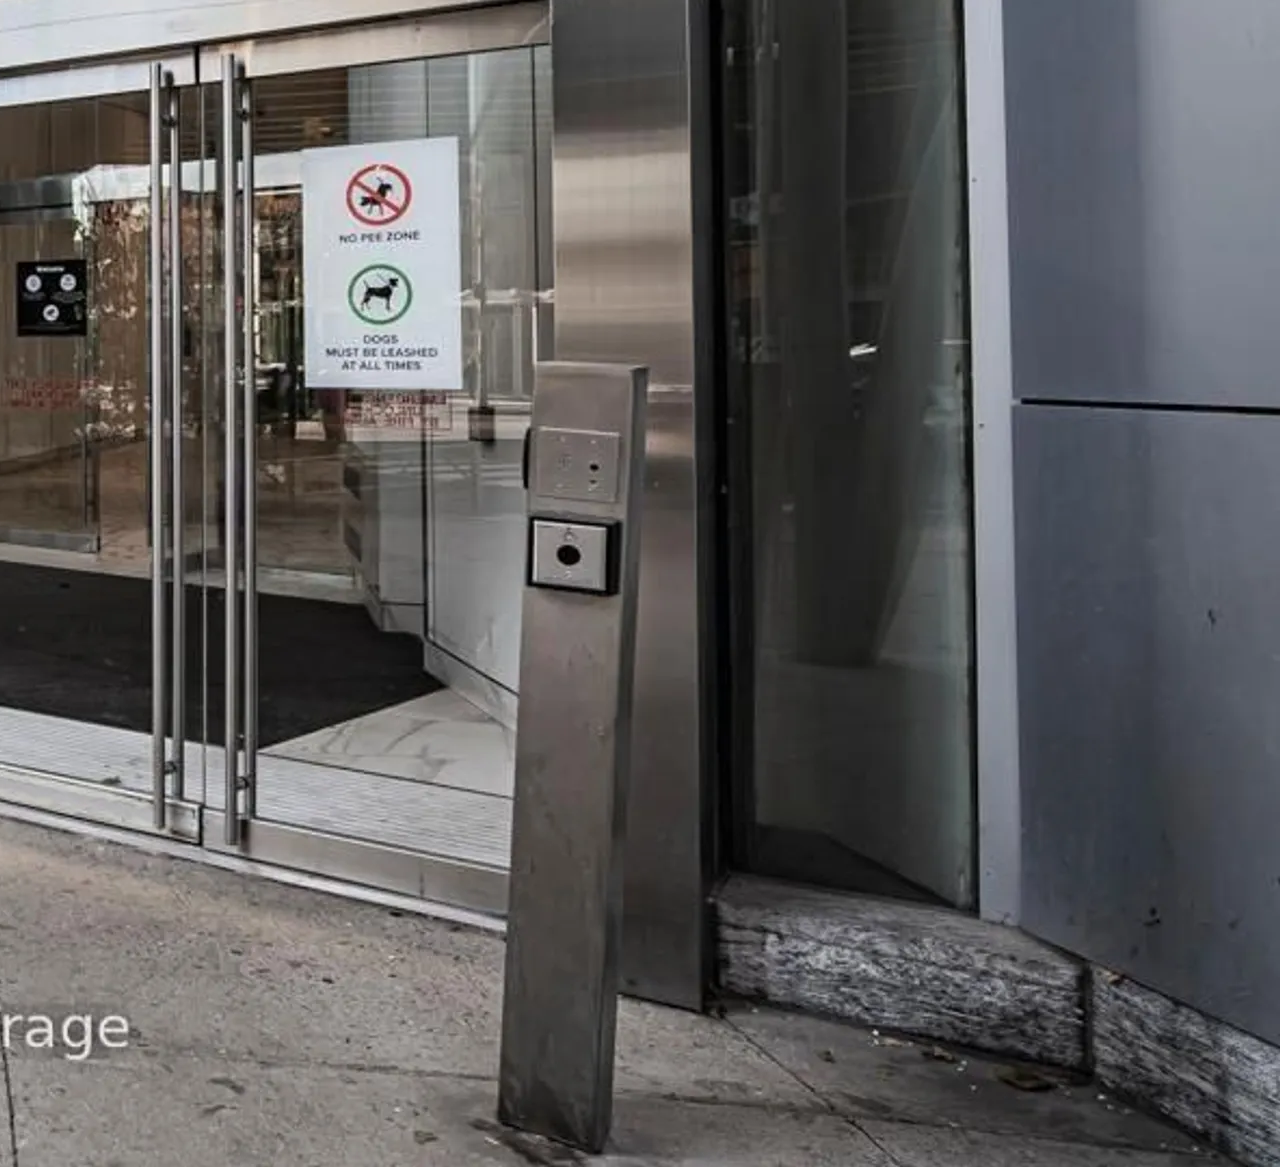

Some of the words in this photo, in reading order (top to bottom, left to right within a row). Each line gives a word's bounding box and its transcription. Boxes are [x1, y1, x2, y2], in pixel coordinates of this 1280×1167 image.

[339, 234, 357, 243] NO
[361, 232, 381, 242] PEE
[387, 230, 420, 241] ZONE
[363, 334, 399, 344] DOGS
[326, 348, 359, 357] MUST
[363, 348, 377, 357] BE
[381, 347, 438, 357] LEASHED
[342, 361, 356, 370] AT
[360, 361, 381, 370] ALL
[385, 360, 421, 370] TIMES
